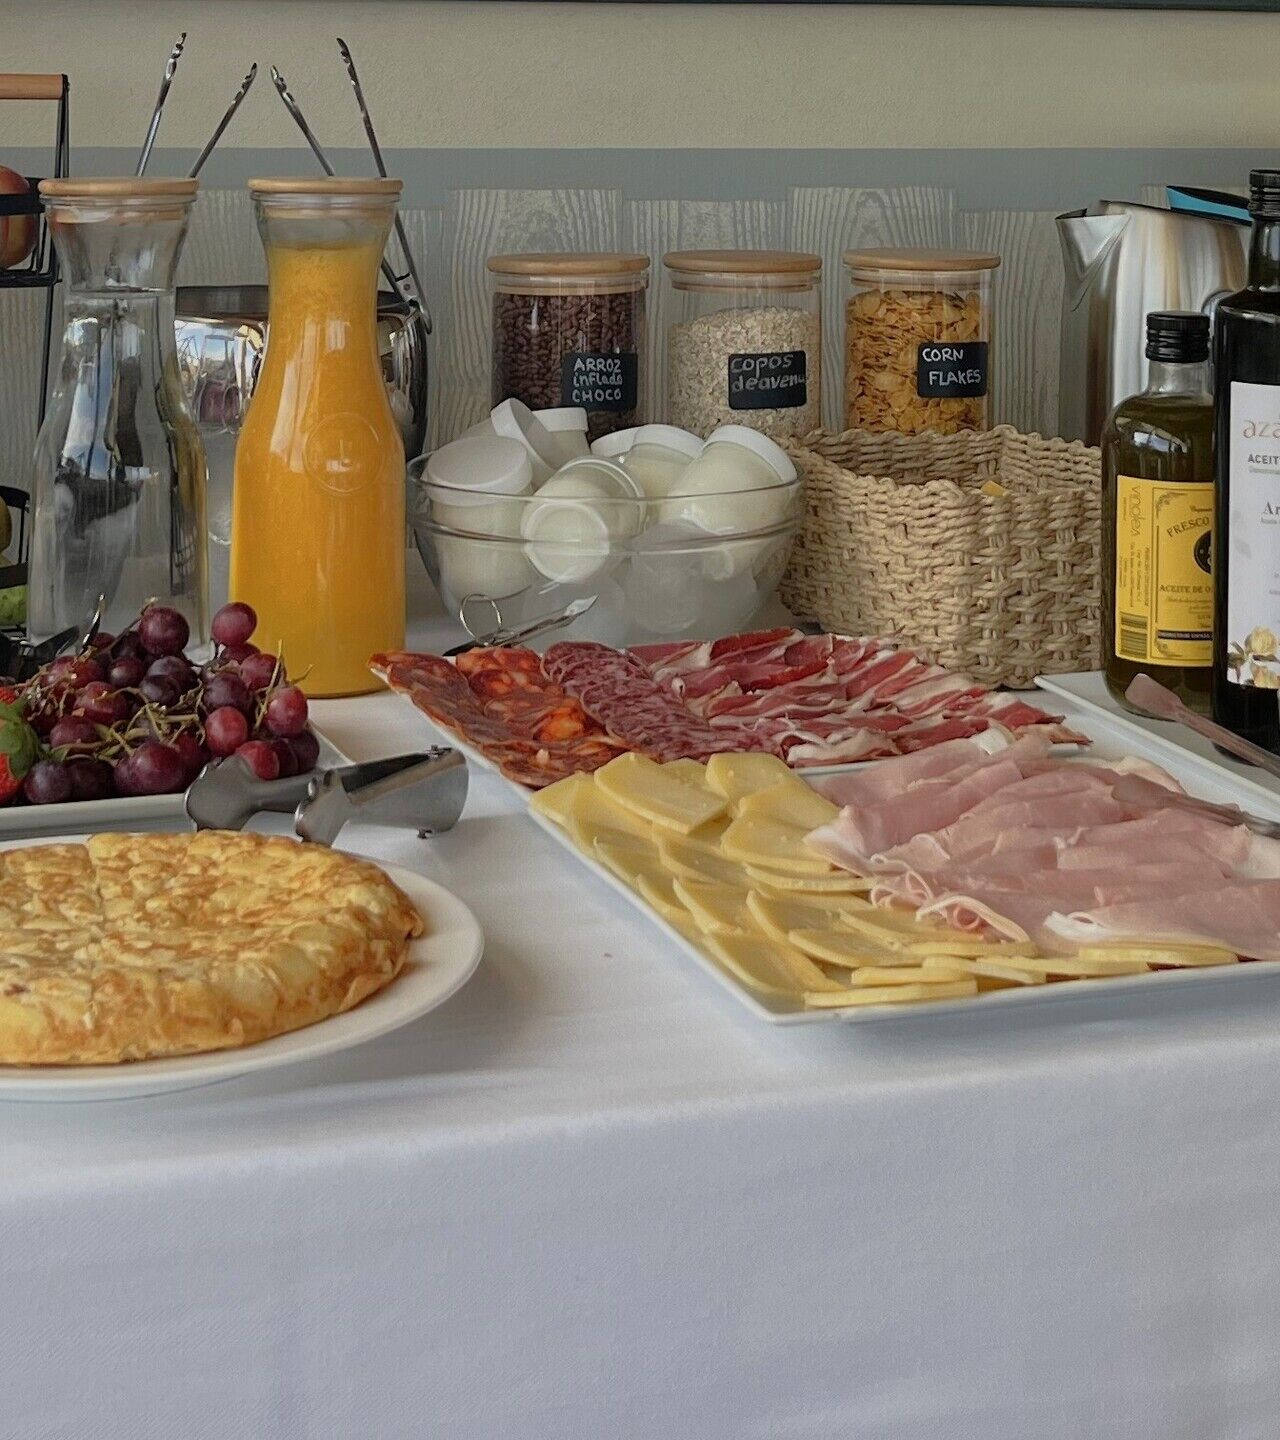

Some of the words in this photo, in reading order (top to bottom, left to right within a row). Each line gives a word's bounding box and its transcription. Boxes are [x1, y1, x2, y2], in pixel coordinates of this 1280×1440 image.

[922, 347, 964, 362] CORN
[573, 357, 622, 373] ARROZ
[928, 369, 982, 386] FLAKES
[572, 388, 622, 403] CHOCO
[1166, 516, 1210, 538] FRESCO
